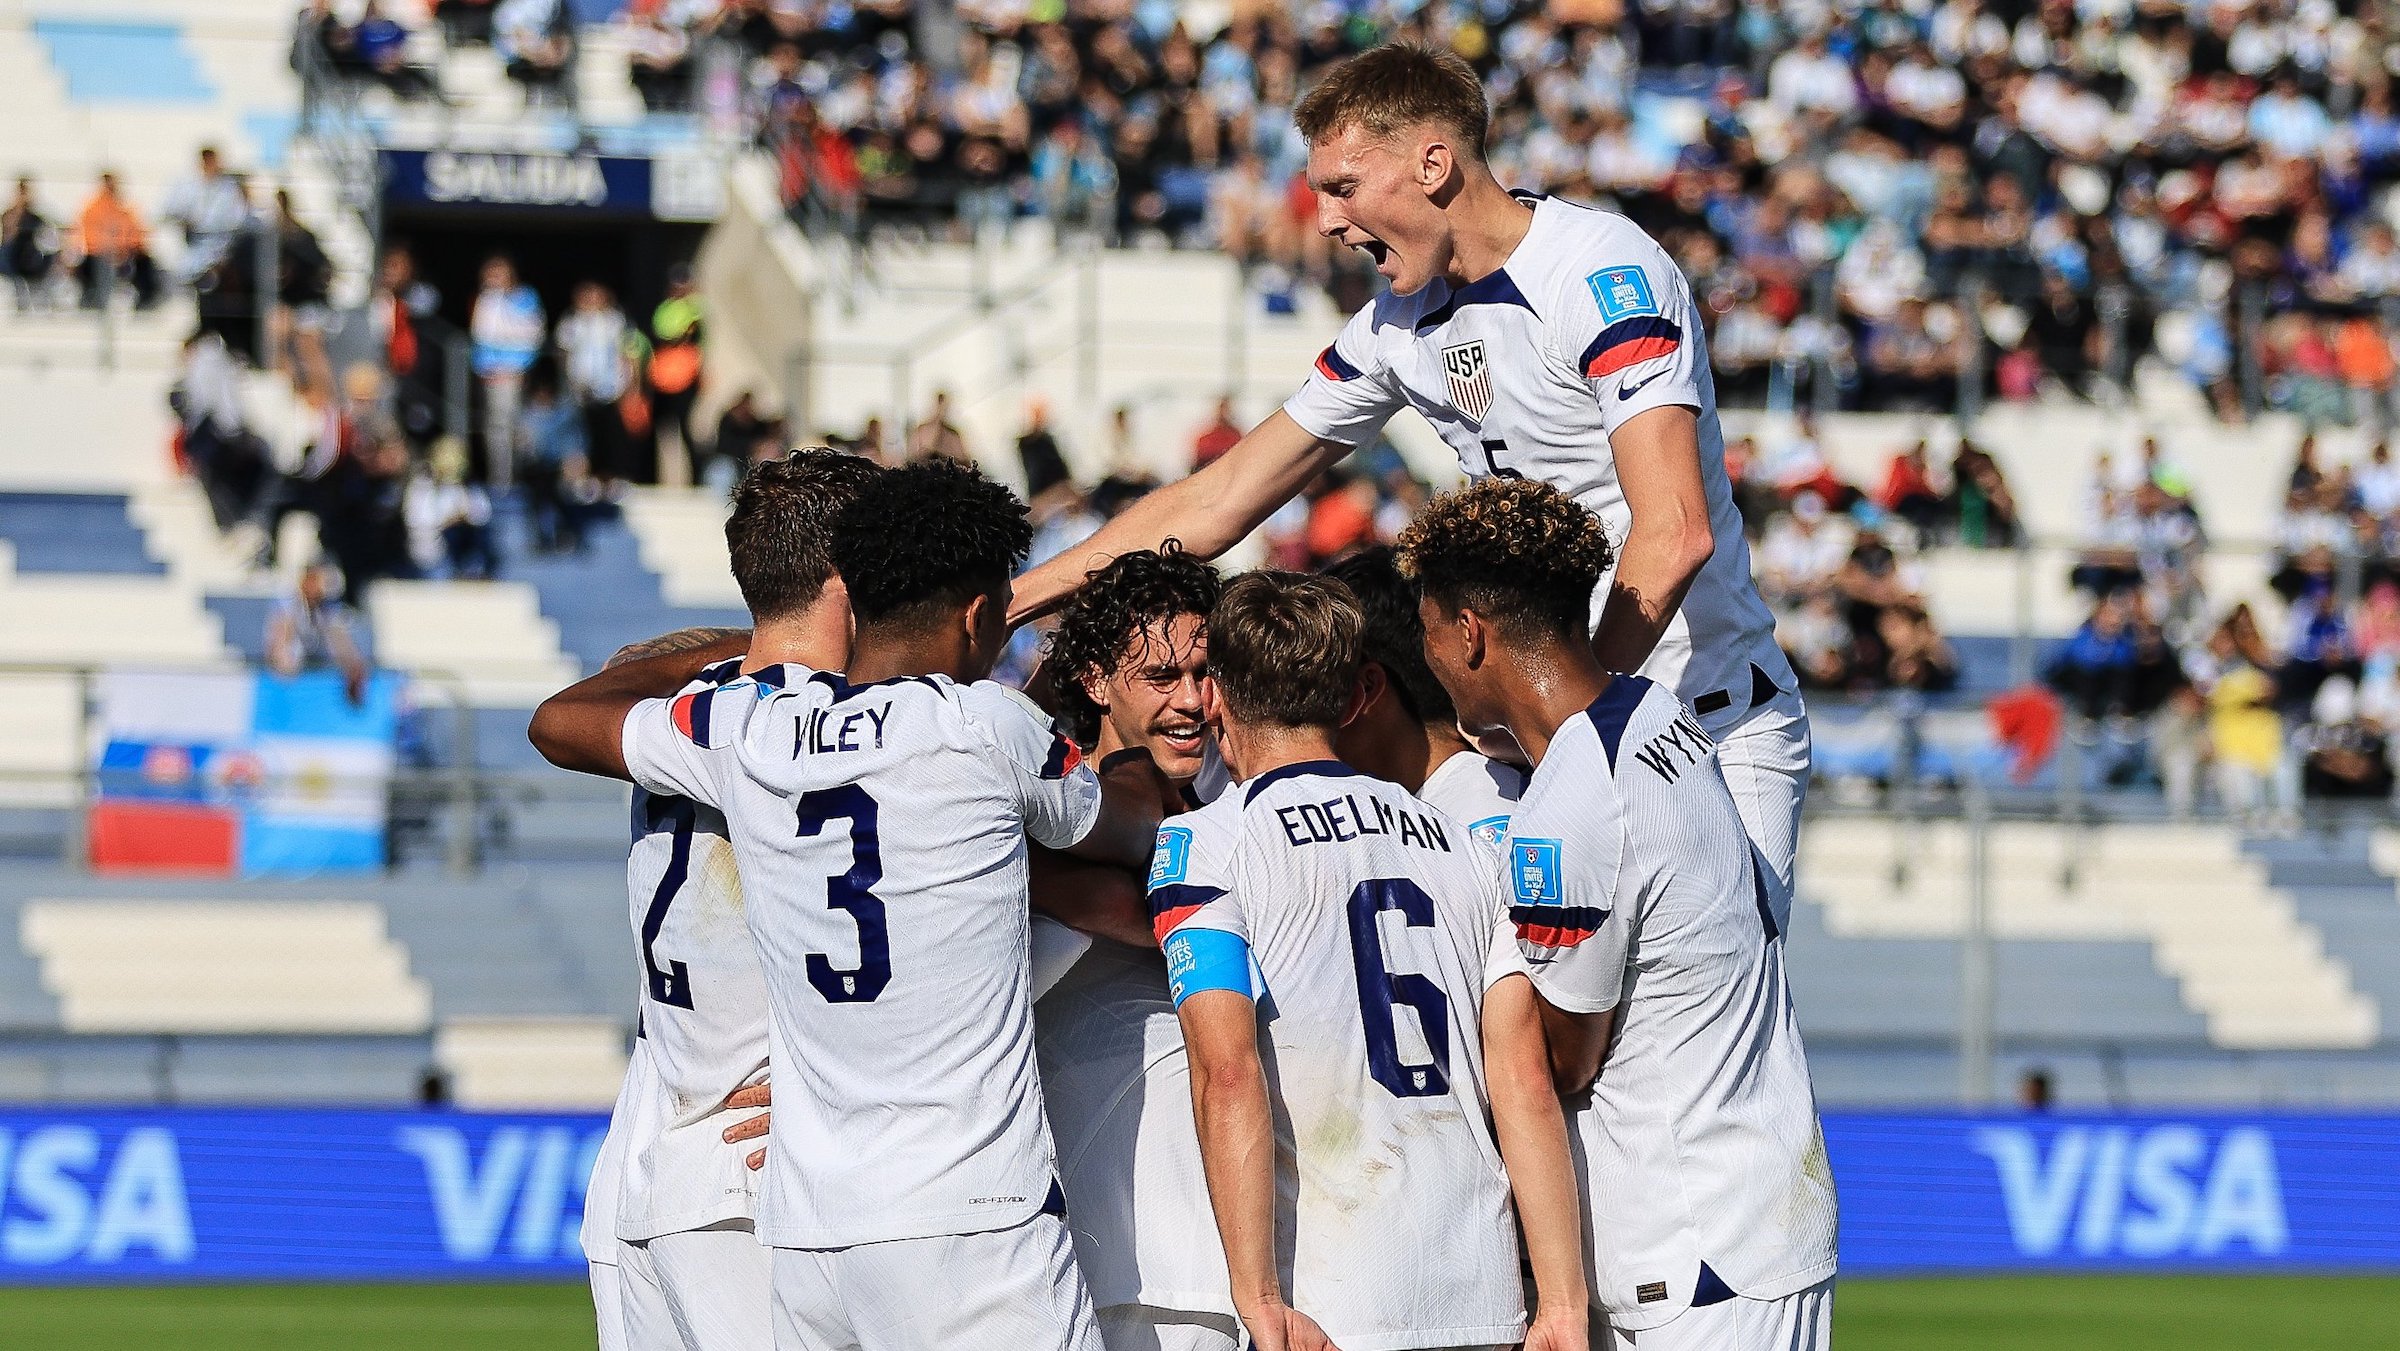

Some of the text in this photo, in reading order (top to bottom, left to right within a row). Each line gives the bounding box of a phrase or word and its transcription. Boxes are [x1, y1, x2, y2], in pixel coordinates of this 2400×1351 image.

[423, 152, 608, 207] SALIDA
[1446, 345, 1483, 378] USA
[1635, 708, 1715, 784] WYN
[1275, 794, 1452, 853] EDELMAN
[642, 795, 694, 1011] 2
[795, 783, 893, 1003] 3
[1346, 878, 1450, 1098] 6
[0, 1125, 198, 1263] SA
[1968, 1125, 2290, 1256] VISA
